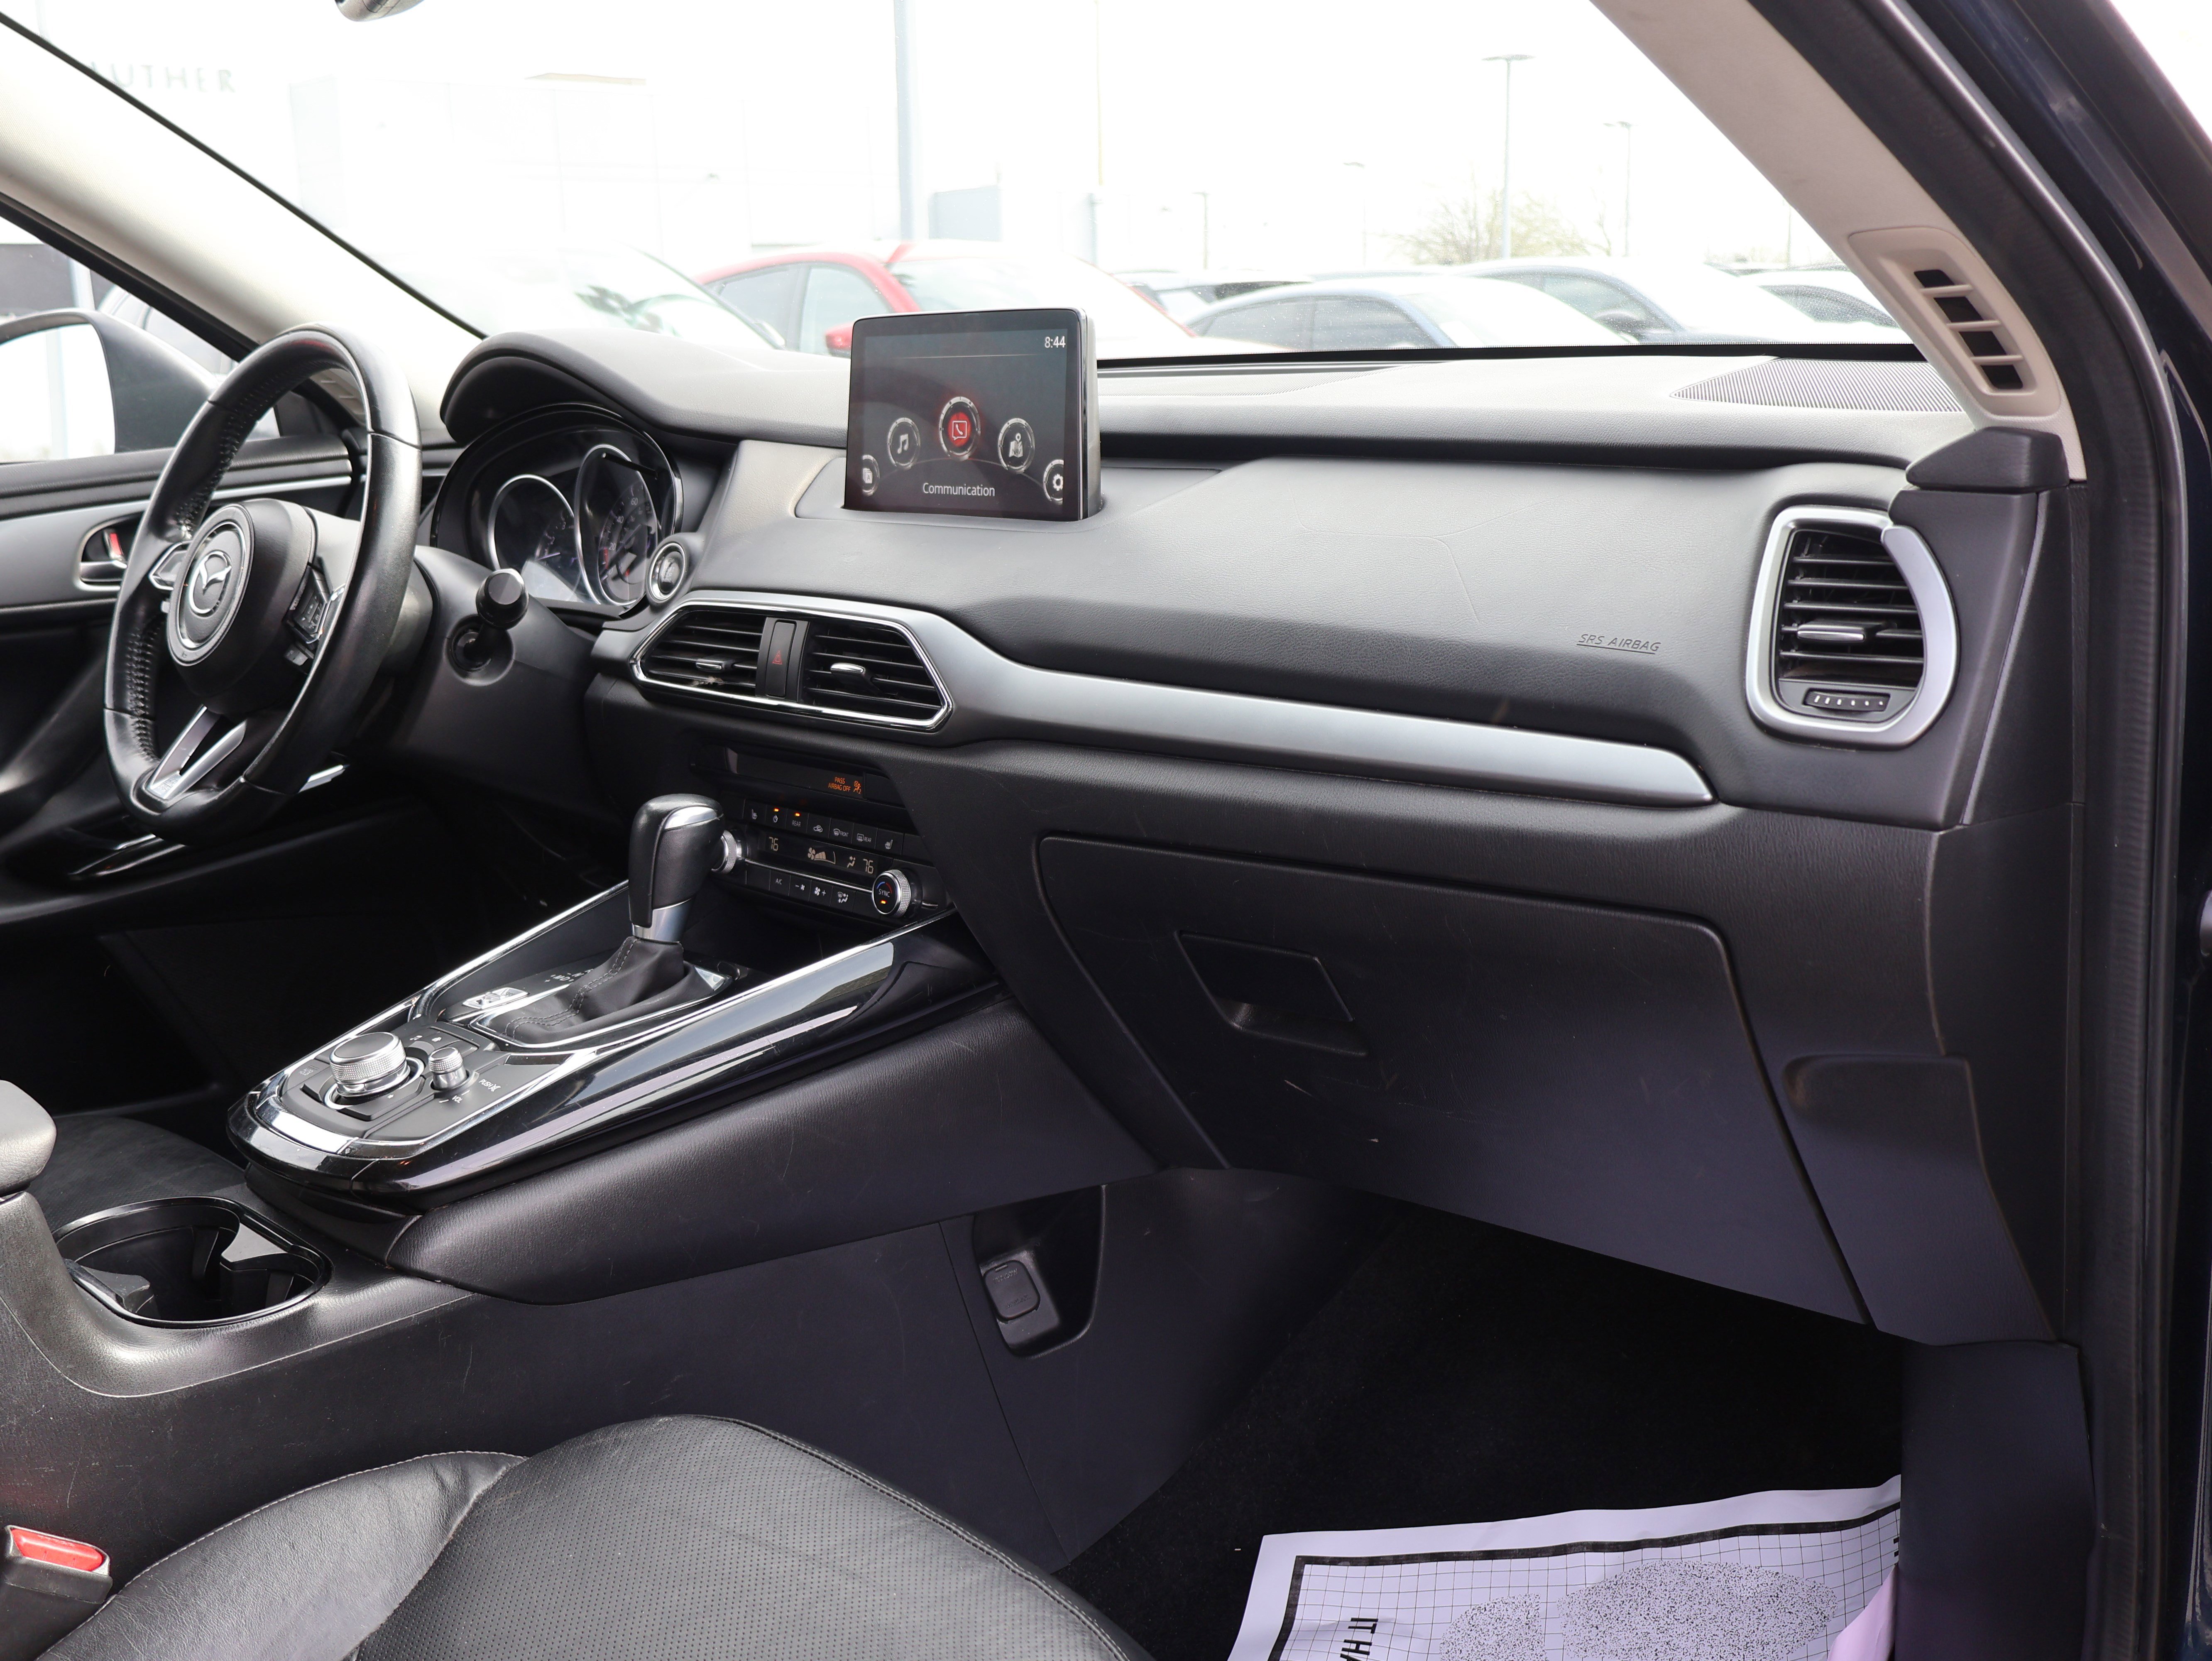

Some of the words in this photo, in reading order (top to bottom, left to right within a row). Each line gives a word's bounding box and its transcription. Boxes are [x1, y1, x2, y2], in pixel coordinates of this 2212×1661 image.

[1045, 336, 1066, 348] 8:44
[922, 482, 996, 497] Communication
[1578, 634, 1605, 645] SRS
[1608, 637, 1661, 652] AIRBAG
[828, 782, 842, 791] AIRBAG
[769, 836, 778, 852] 76
[863, 858, 874, 875] 76
[878, 889, 891, 898] SYNC
[479, 1079, 494, 1090] PUSH
[452, 1095, 463, 1103] VOL
